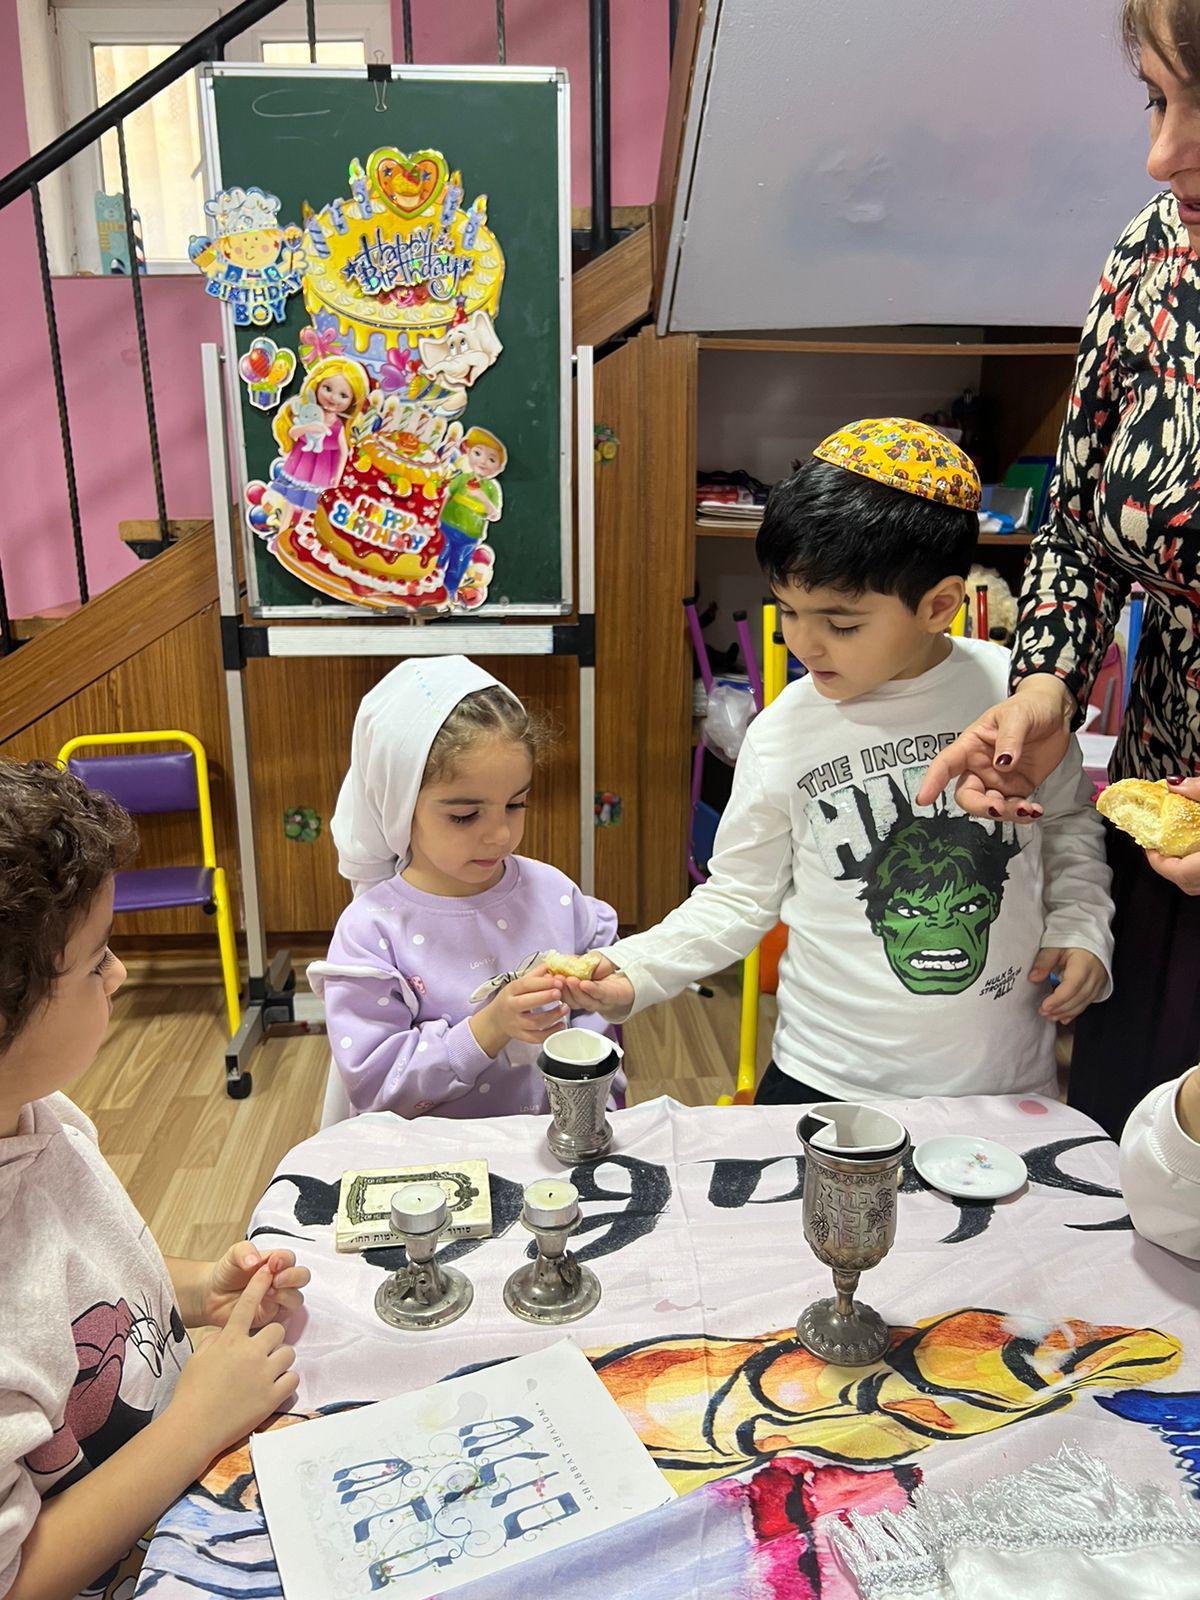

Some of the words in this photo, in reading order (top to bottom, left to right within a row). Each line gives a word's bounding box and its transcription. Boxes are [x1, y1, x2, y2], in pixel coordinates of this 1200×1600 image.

[354, 225, 433, 268] Happy
[207, 270, 301, 302] BIRTHDAY
[234, 299, 285, 324] BOY
[332, 502, 426, 551] BIRTHDAY
[357, 498, 415, 532] HAPPY
[797, 755, 853, 798] THE
[538, 1408, 565, 1449] SHALOM
[444, 1416, 580, 1540] שלום
[561, 1452, 594, 1502] SHABBAT
[332, 1458, 453, 1592] שבת
